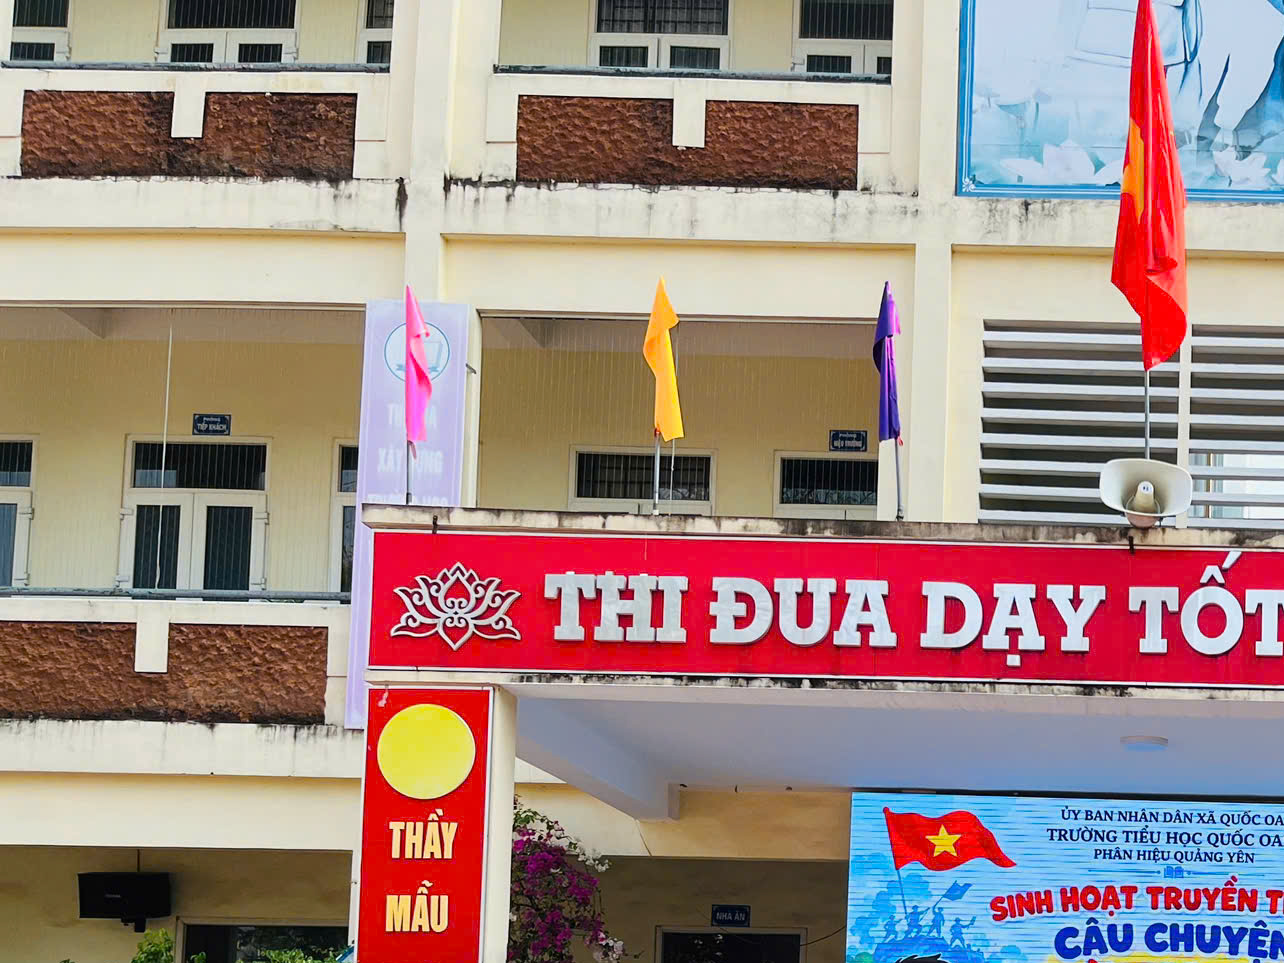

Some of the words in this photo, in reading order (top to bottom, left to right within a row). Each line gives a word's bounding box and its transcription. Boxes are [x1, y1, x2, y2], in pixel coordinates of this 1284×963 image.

[544, 571, 688, 643] THI
[709, 576, 897, 648] ĐUA
[920, 580, 1106, 667] DẠY
[389, 808, 458, 859] THẦY
[1047, 826, 1117, 843] TRƯỜNG
[1122, 825, 1161, 845] TIỂU
[1166, 831, 1202, 848] HỌC
[1207, 828, 1254, 849] QUỐC
[1061, 805, 1081, 820] ỦY
[1084, 809, 1117, 822] BAN
[1118, 808, 1159, 823] NHÂN
[1163, 810, 1193, 824] DÂN
[1197, 810, 1217, 825] XÃ
[1220, 810, 1262, 828] QUỐC
[1094, 847, 1133, 861] PHÂN
[1137, 848, 1170, 864] HIỆU
[1174, 848, 1223, 866] QUẢNG
[1228, 850, 1255, 864] YÊN
[385, 880, 449, 933] MẪU
[990, 890, 1052, 922] SINH
[1060, 885, 1138, 917] HOẠT
[1146, 875, 1258, 912] TRUYỀN
[1054, 917, 1133, 960] CÂU
